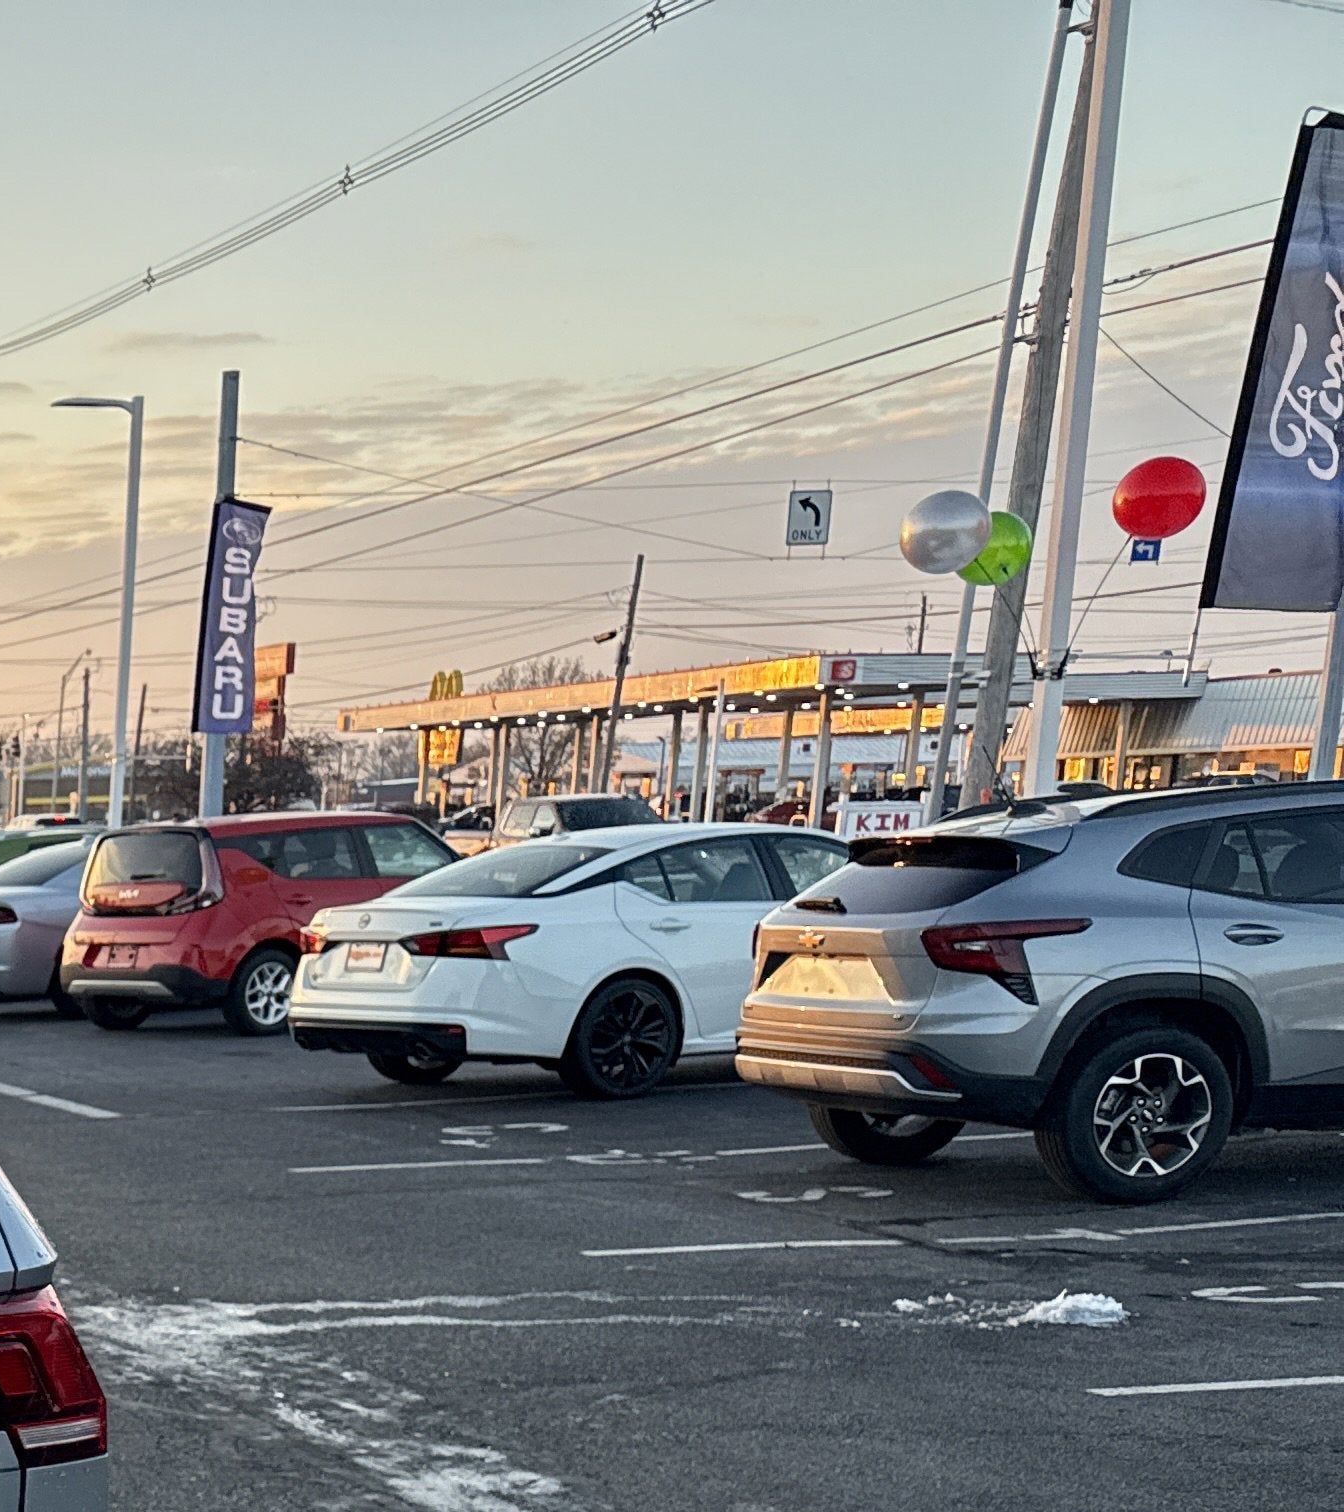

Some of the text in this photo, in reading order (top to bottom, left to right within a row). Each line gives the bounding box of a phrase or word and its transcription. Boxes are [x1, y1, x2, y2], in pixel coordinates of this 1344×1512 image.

[791, 529, 822, 541] ONLY
[212, 546, 252, 720] SUBARU
[856, 813, 910, 832] KIM
